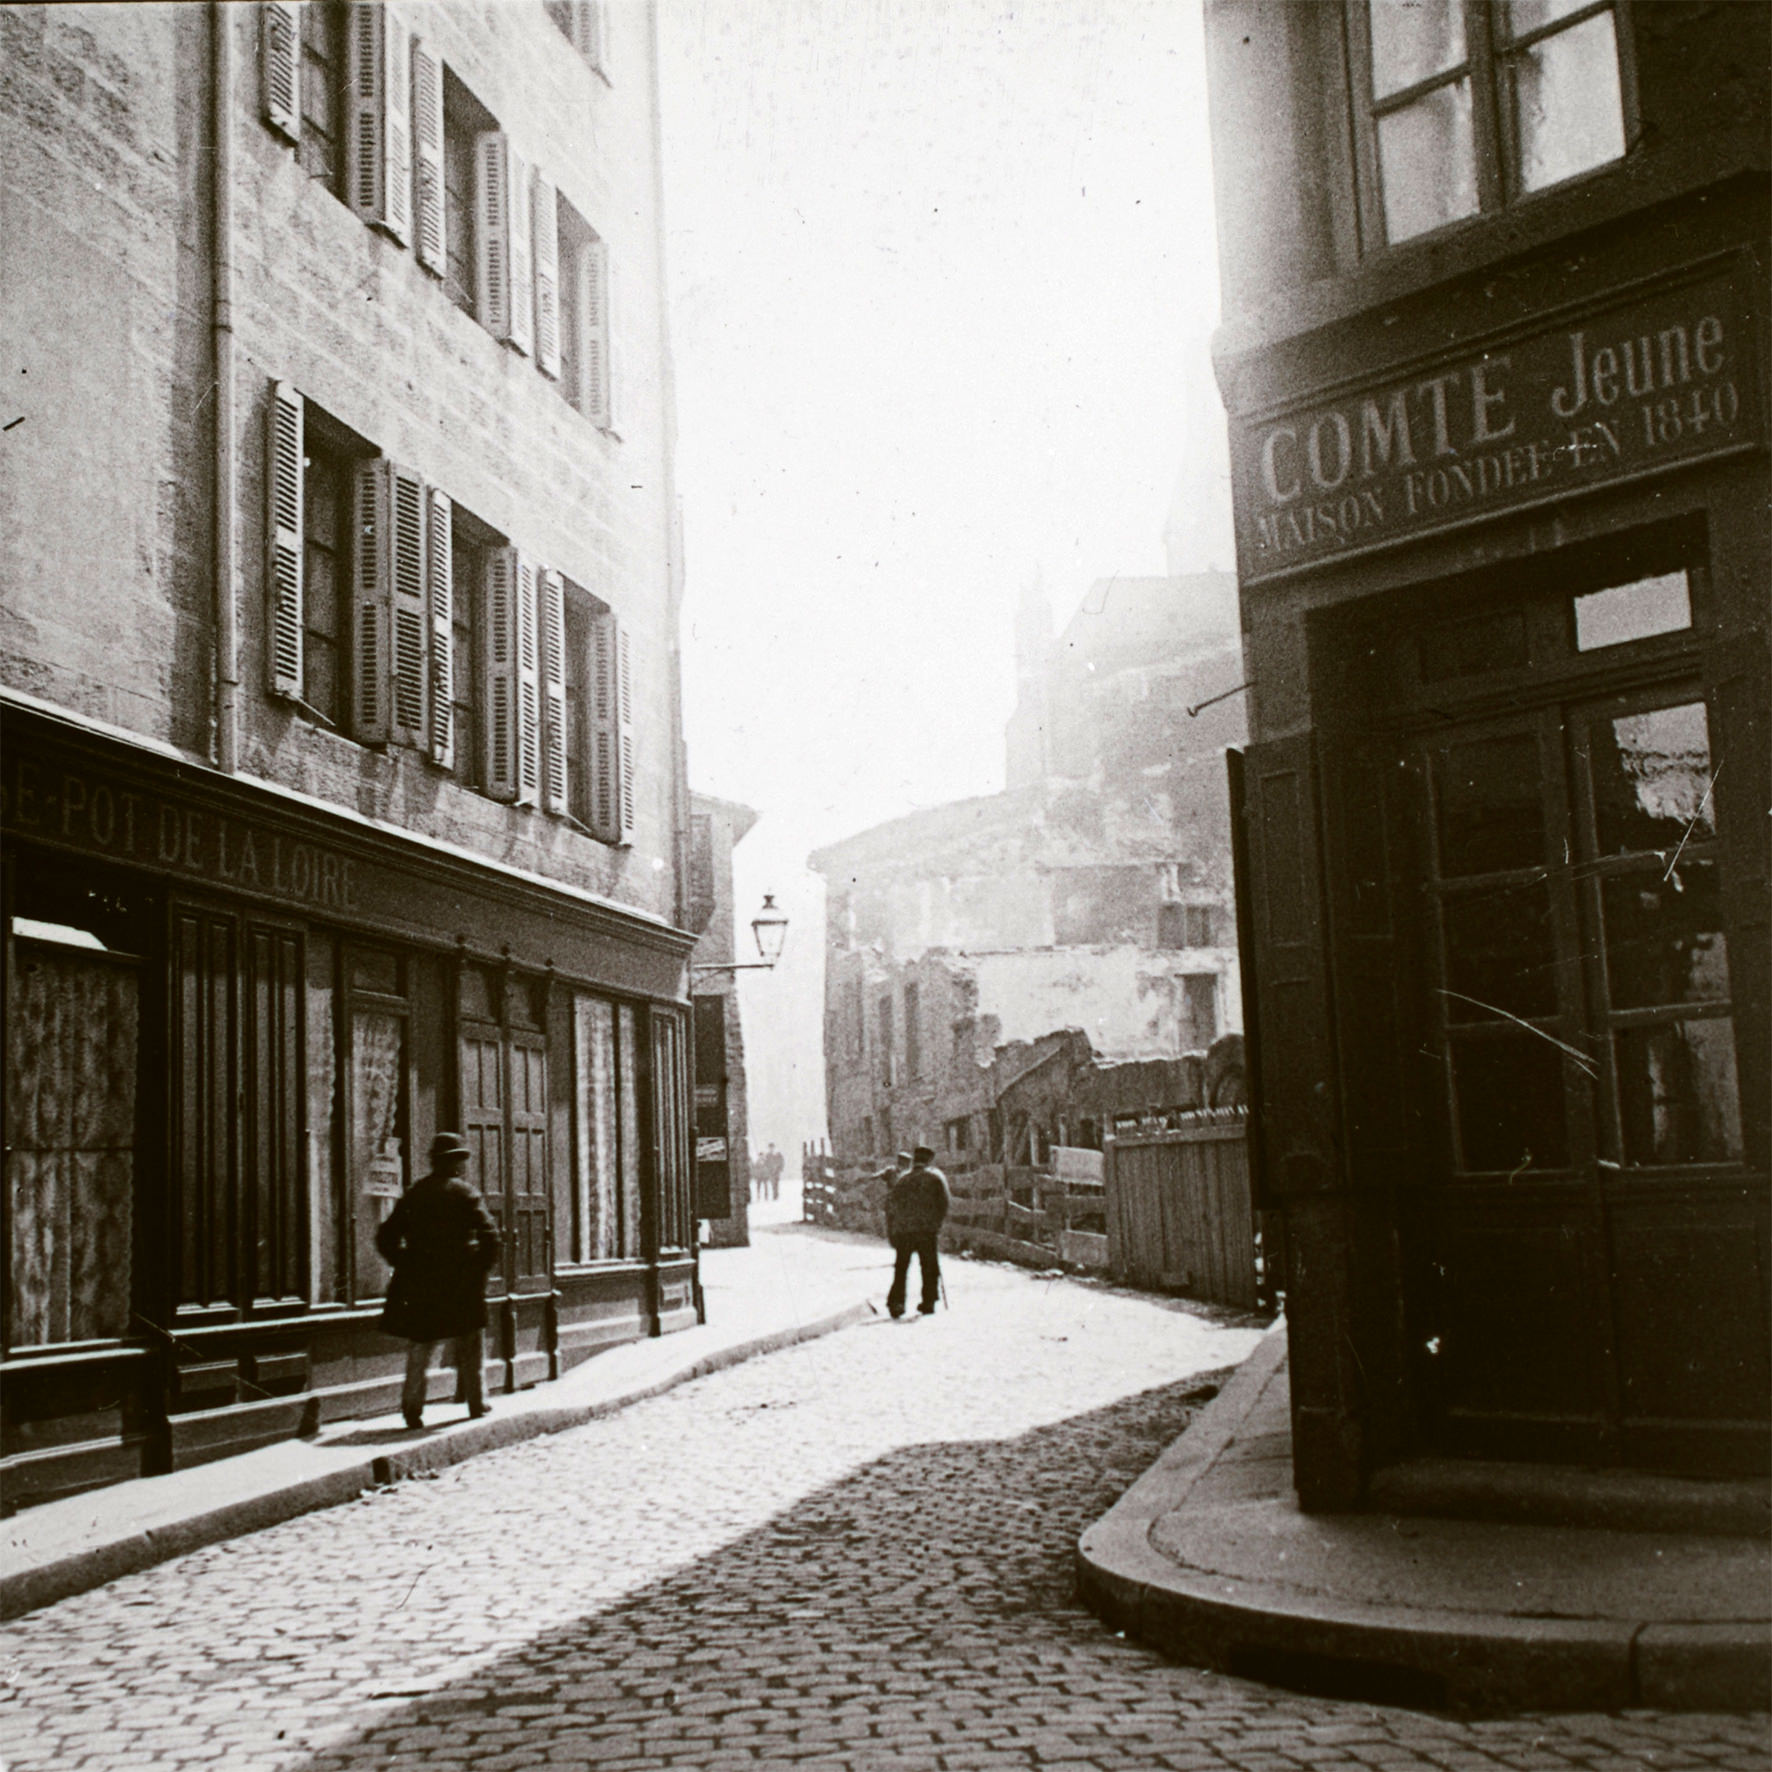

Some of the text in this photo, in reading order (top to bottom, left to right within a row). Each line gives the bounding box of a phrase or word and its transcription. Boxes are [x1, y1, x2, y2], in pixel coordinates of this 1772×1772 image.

[1257, 486, 1384, 555] MAISON
[1569, 419, 1621, 468] EN
[1641, 382, 1739, 446] 1840
[1261, 315, 1724, 502] COMTE Jeune
[158, 803, 203, 870] DE
[218, 818, 259, 883] LA
[273, 837, 357, 912] LOIRE
